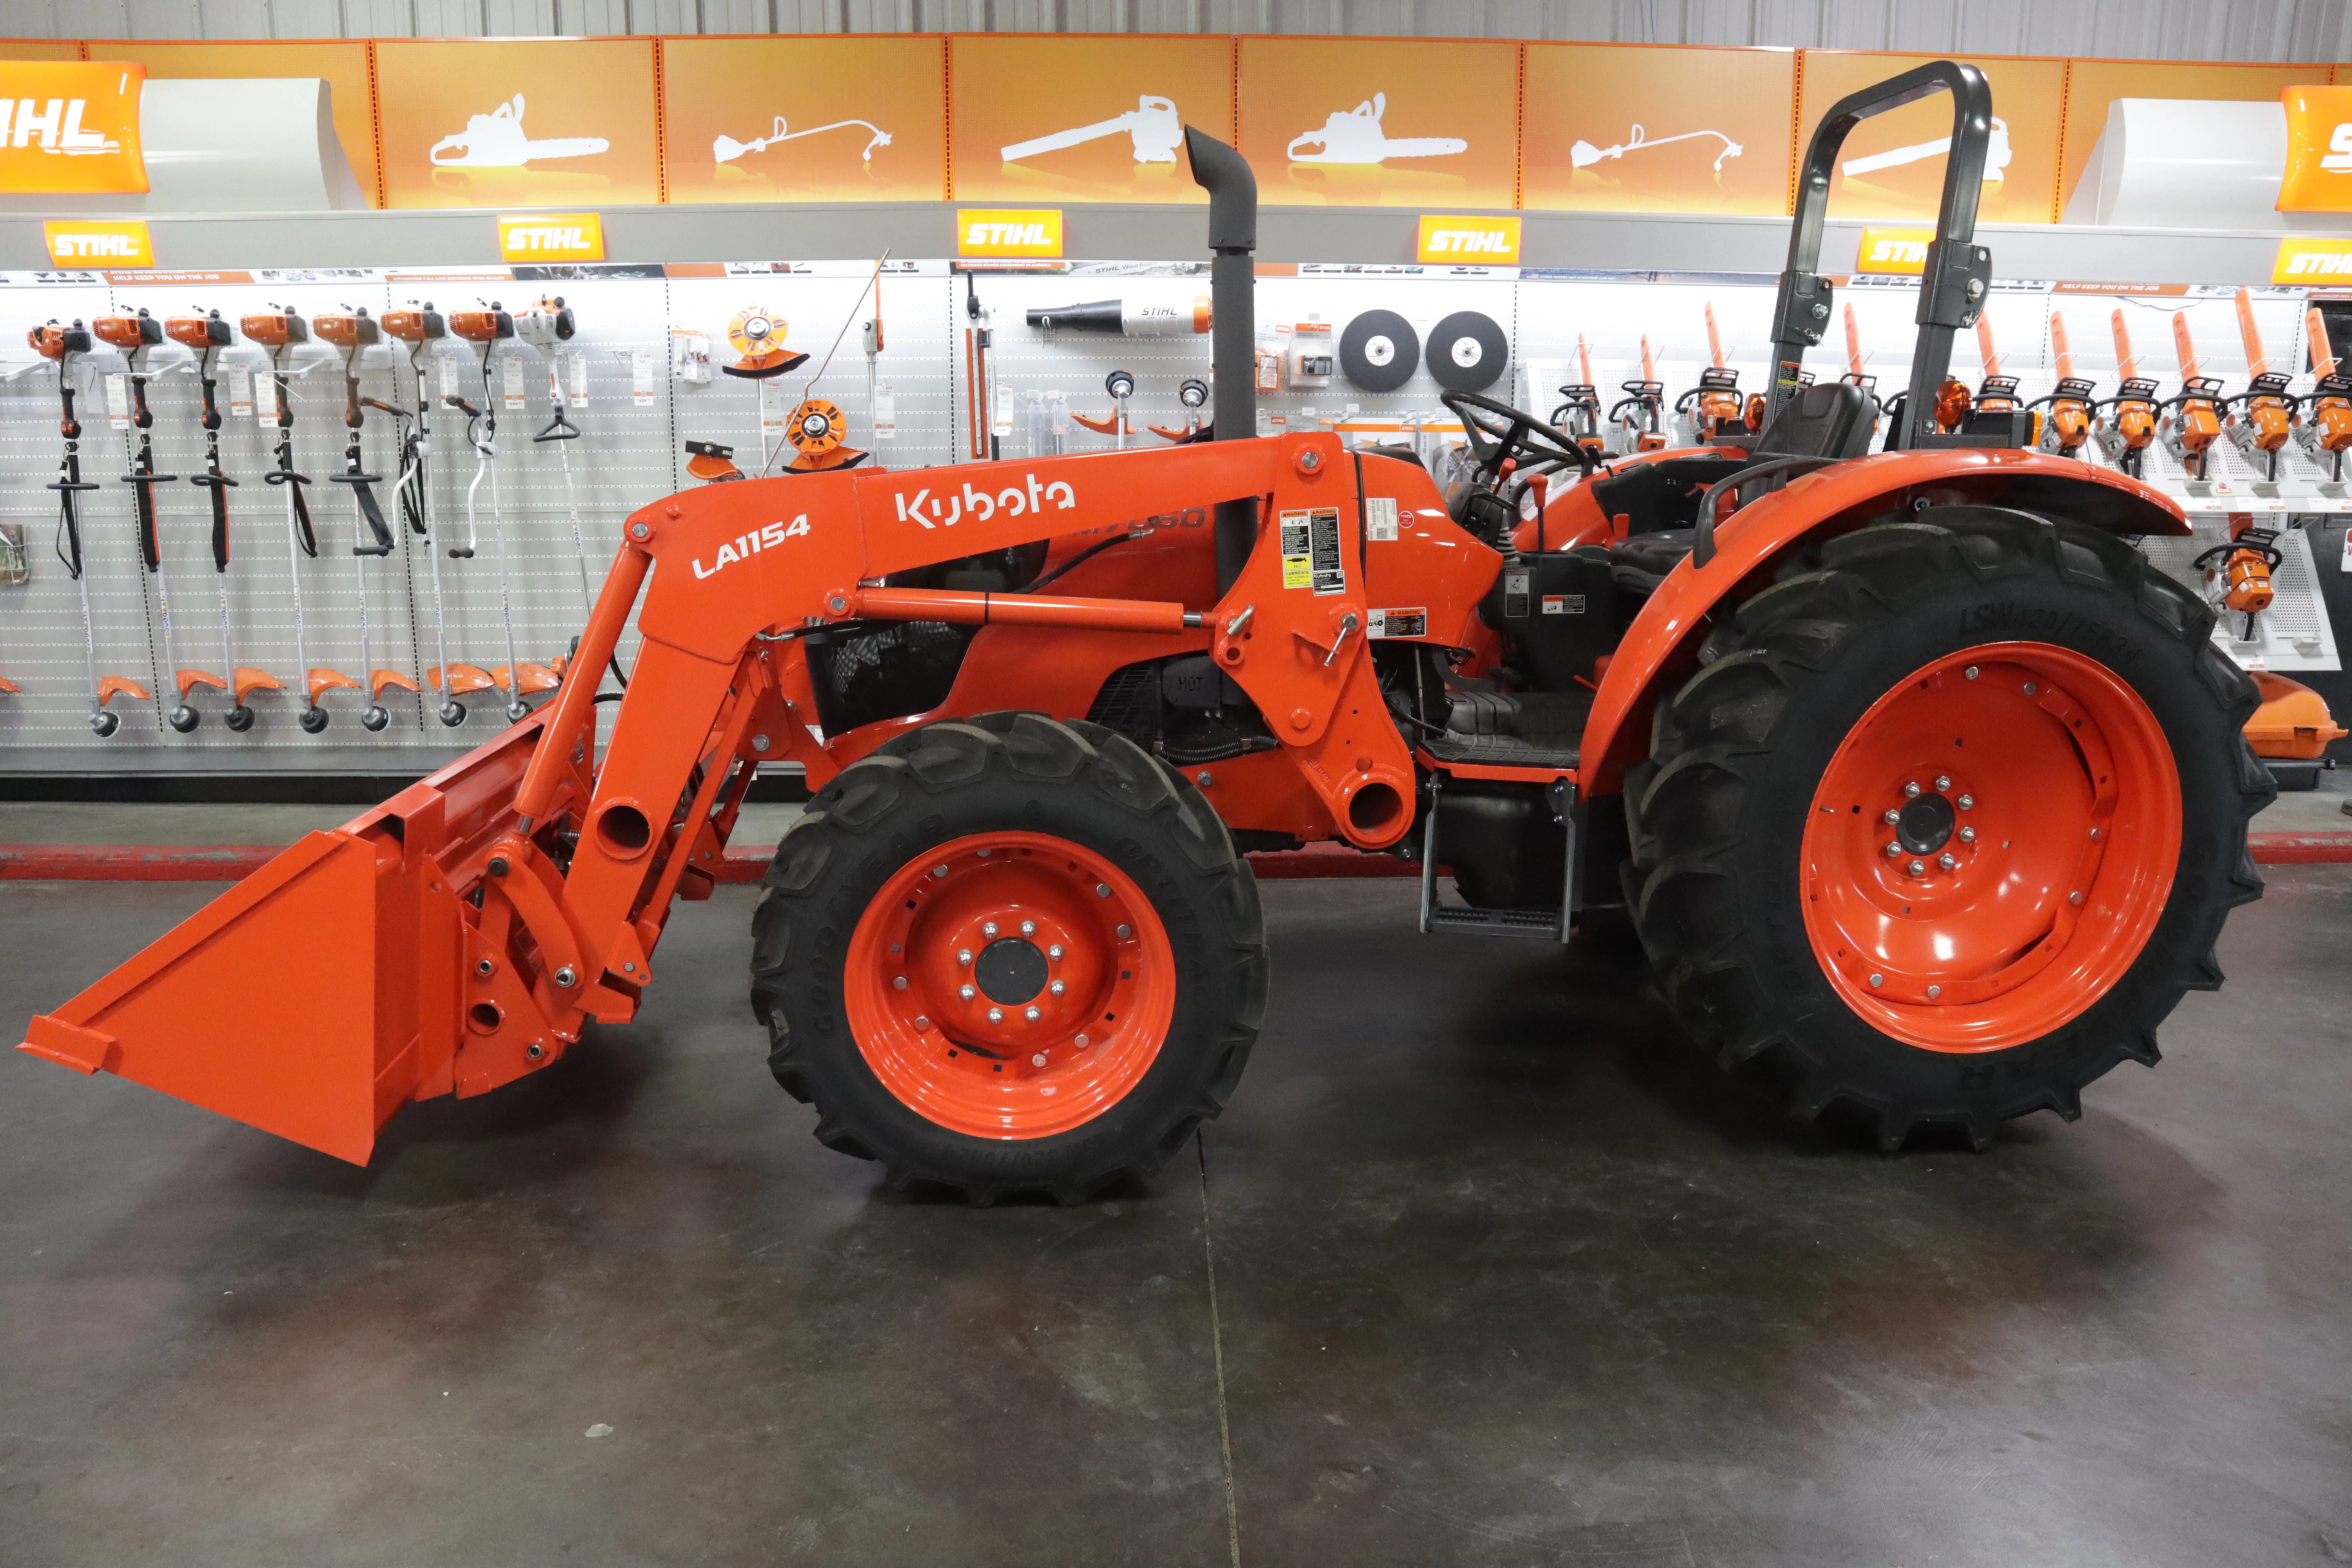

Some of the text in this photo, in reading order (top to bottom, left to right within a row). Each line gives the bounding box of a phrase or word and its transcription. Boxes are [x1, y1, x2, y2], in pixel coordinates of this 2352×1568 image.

[0, 99, 105, 147] IHL
[54, 234, 139, 256] STIHL
[506, 227, 591, 250] STIHL
[967, 223, 1052, 245] STIHL
[1428, 230, 1512, 252] STIHL
[1870, 240, 1927, 262] STIH
[1142, 307, 1177, 316] STIHL
[895, 473, 1076, 529] Kubota
[691, 514, 811, 579] LA1154
[1960, 601, 2014, 636] LSW
[1178, 675, 1203, 692] HOT
